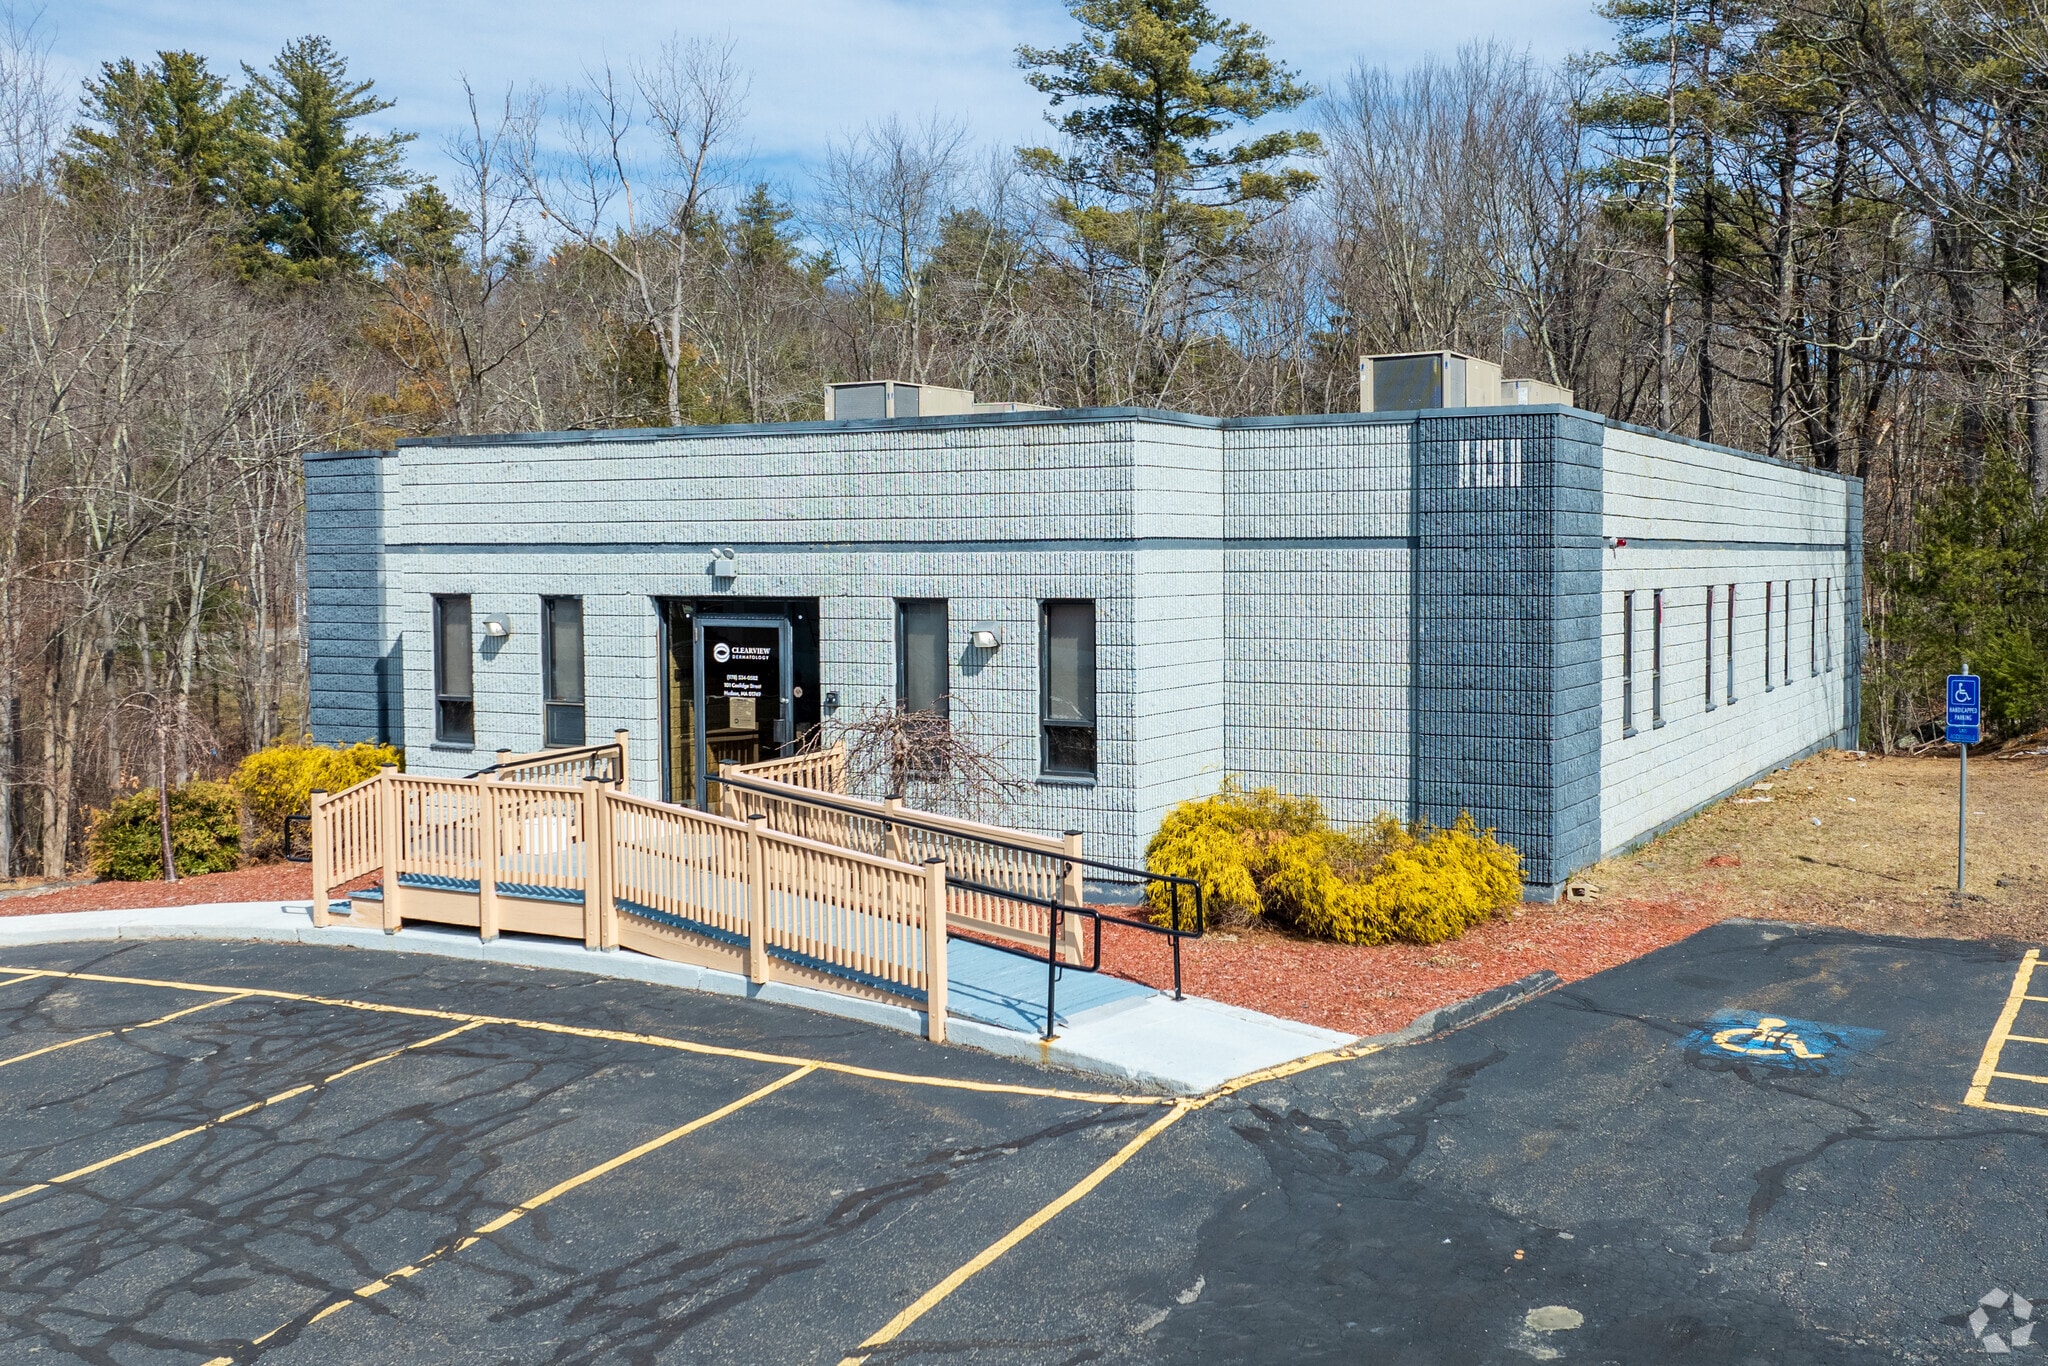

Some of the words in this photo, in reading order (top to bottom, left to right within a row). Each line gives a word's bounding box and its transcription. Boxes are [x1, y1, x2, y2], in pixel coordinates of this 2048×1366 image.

[1459, 438, 1521, 488] 101
[731, 647, 771, 655] CLEARVIEW
[1949, 706, 1978, 714] HANDICAPPED
